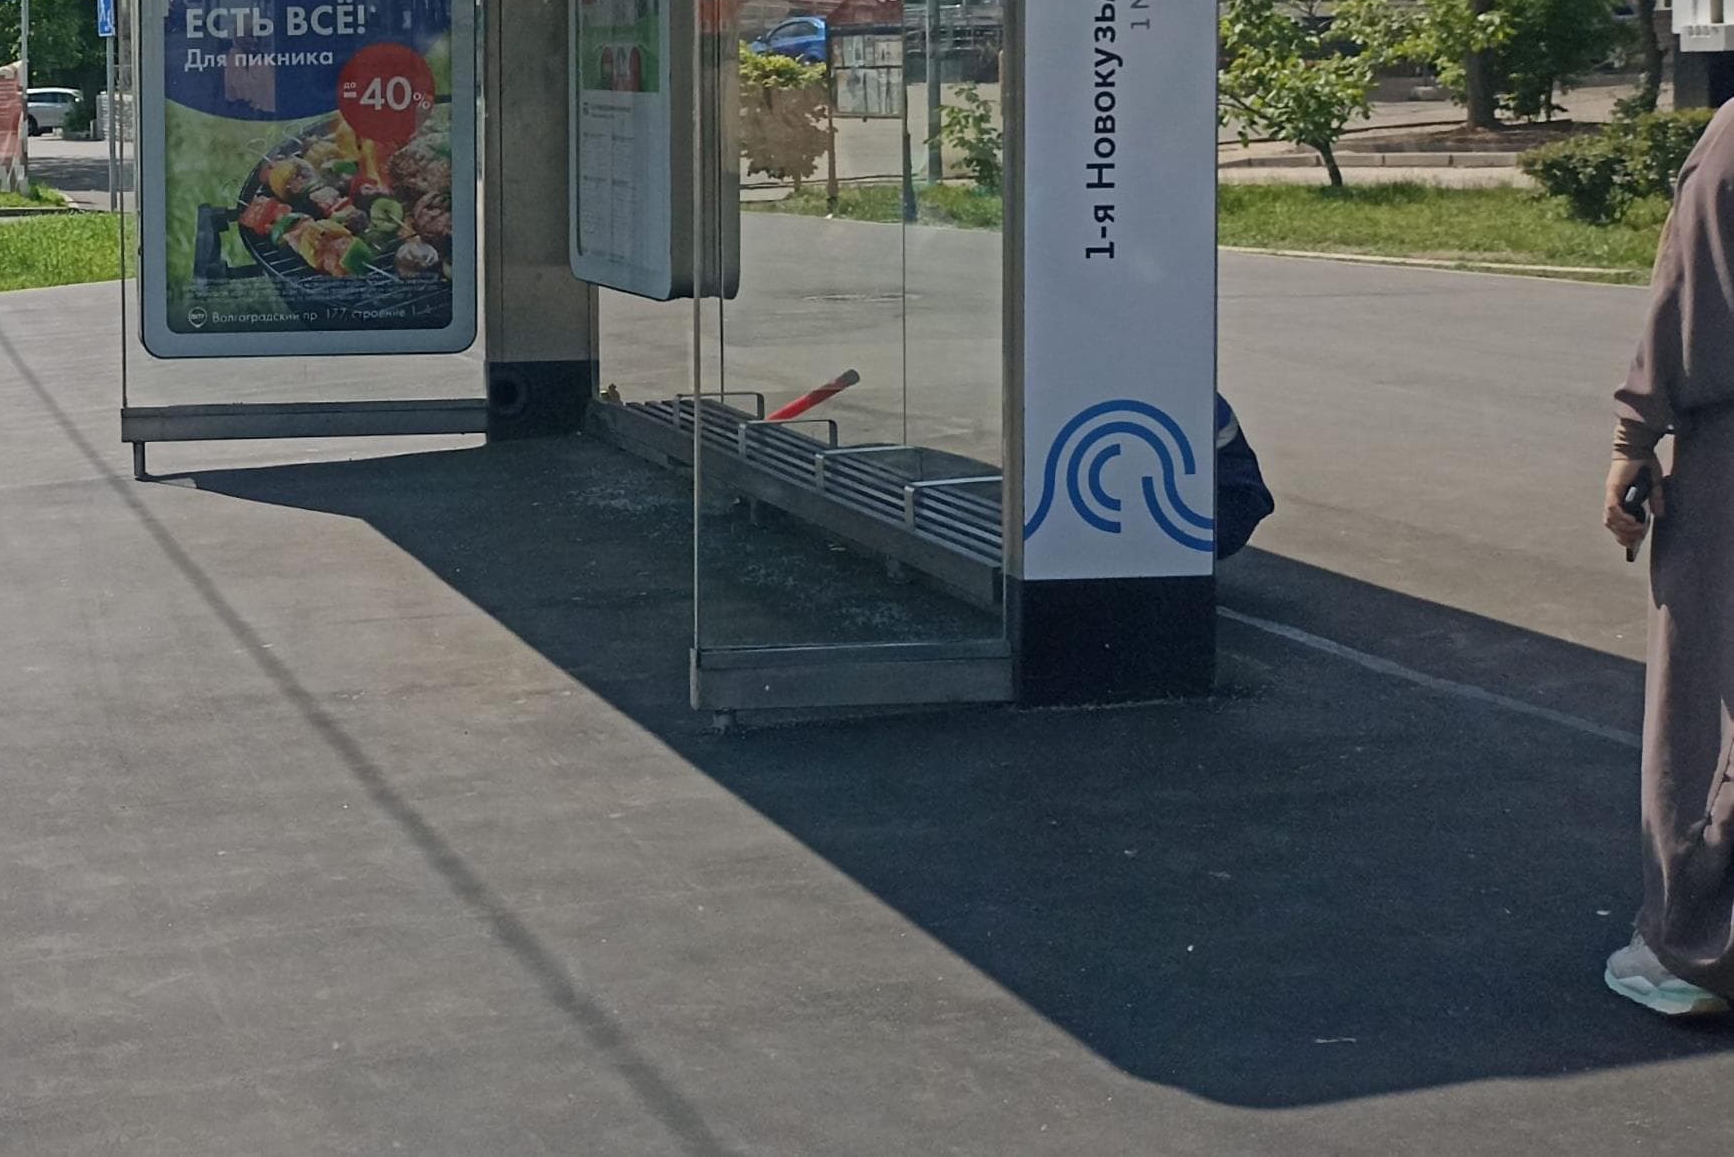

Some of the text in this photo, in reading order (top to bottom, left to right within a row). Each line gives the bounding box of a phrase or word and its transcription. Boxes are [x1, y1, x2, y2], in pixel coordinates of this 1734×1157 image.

[185, 7, 275, 39] ЕСТЬ
[1130, 17, 1151, 30] 1
[184, 48, 334, 73] Для пикника
[1085, 203, 1115, 260] 1-я
